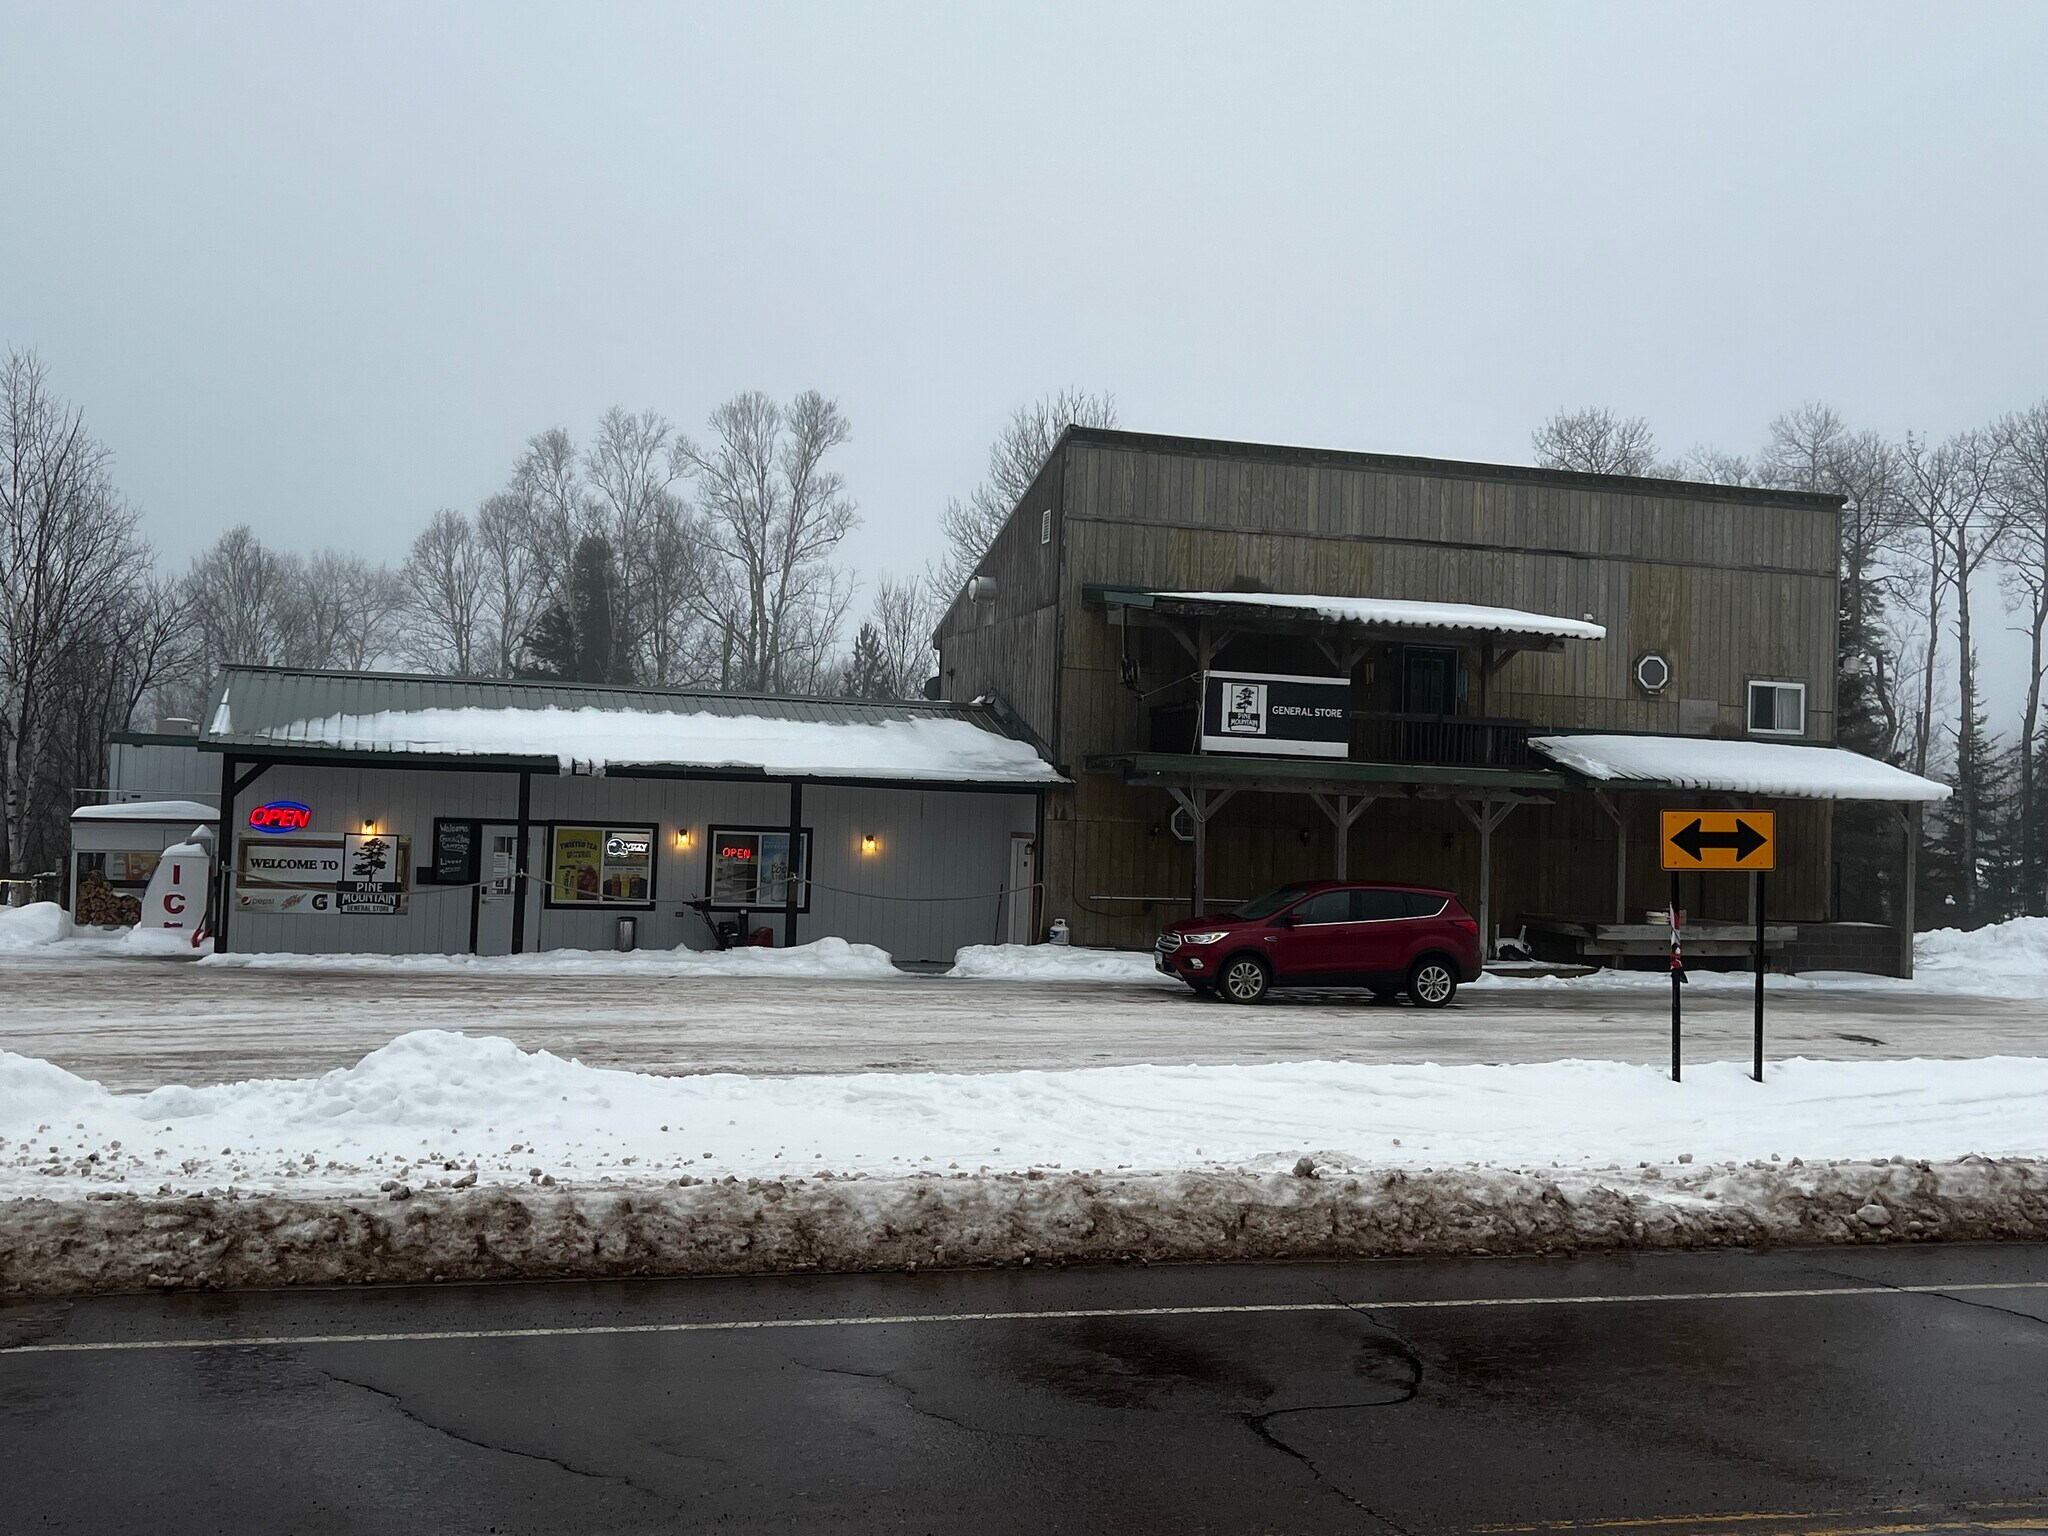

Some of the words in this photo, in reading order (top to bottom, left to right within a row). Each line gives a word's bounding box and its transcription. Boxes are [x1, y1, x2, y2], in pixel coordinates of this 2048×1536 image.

[1272, 705, 1313, 717] GENERAL
[1314, 708, 1343, 718] STORE
[1231, 718, 1258, 727] MOUNTAIN
[250, 807, 311, 828] OPEN
[722, 847, 751, 859] OPEN
[250, 858, 318, 869] WELCOME
[320, 860, 339, 870] TO
[356, 882, 383, 893] PINE
[312, 894, 328, 910] G
[341, 893, 396, 906] MOUNTAIN
[347, 905, 371, 913] GENERAL
[372, 905, 389, 913] STORE
